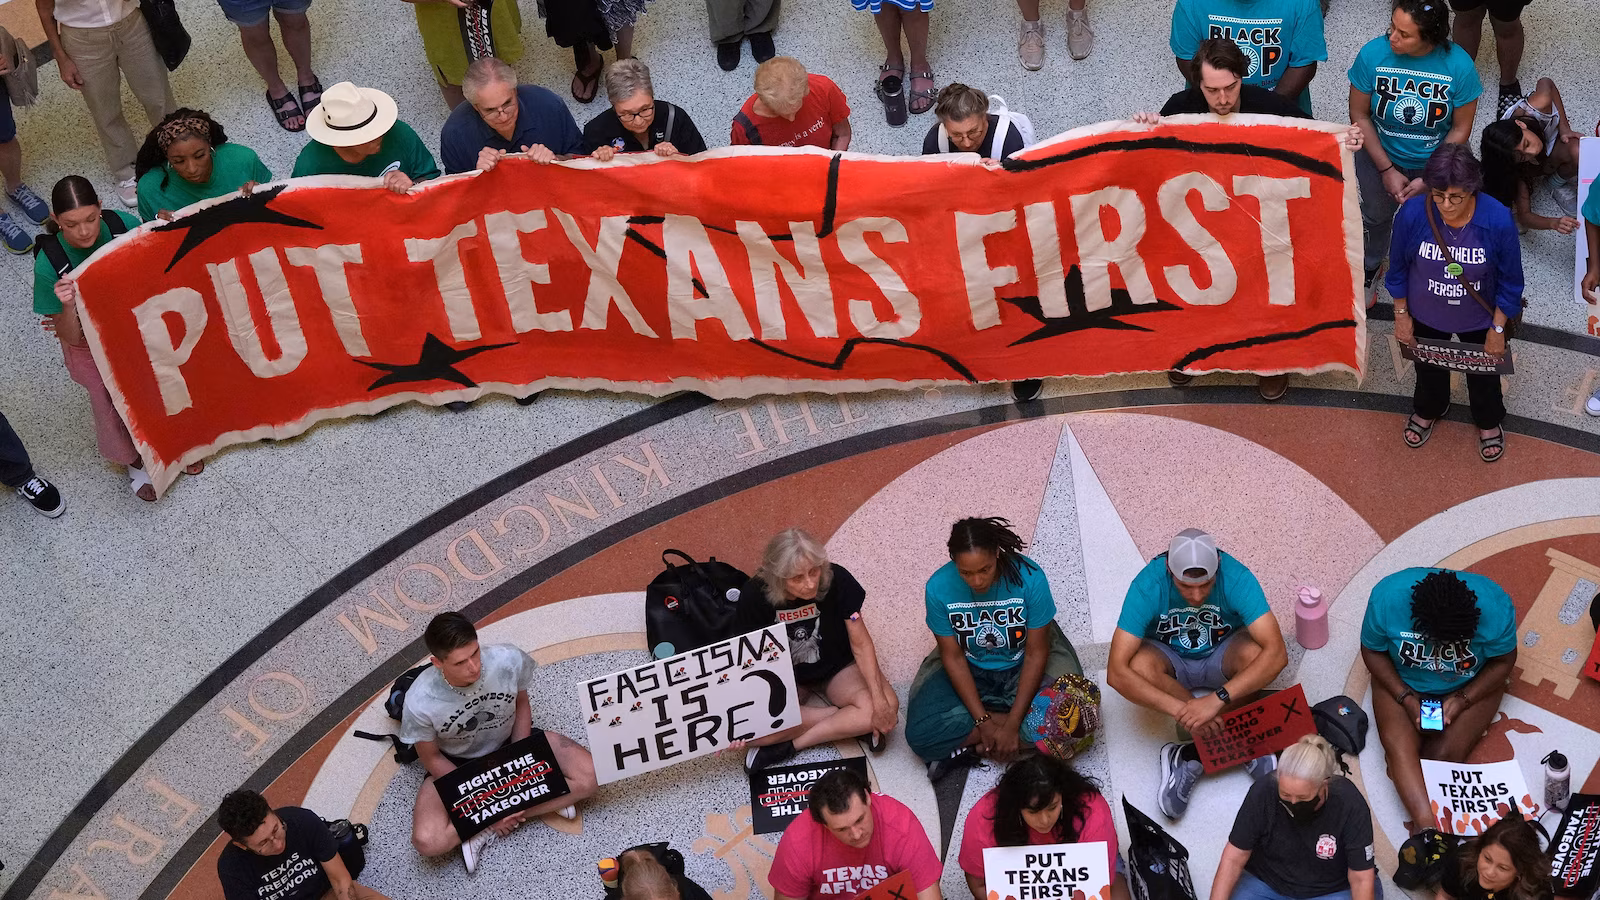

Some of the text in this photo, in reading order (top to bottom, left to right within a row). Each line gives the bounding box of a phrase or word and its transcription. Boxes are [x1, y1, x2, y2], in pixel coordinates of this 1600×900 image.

[467, 29, 480, 60] IGHT
[1208, 24, 1282, 46] BLACK
[1375, 76, 1450, 101] BLACK
[1375, 89, 1449, 128] TOP
[802, 130, 808, 138] a
[131, 170, 1311, 417] PUT TEXANS FIRST
[1416, 343, 1460, 355] FIGHT
[1418, 356, 1496, 372] TAKEOVER
[714, 394, 868, 460] THE
[333, 441, 675, 656] KINGDOM
[778, 605, 815, 621] RESIST
[949, 606, 1026, 628] BLACK
[1157, 610, 1224, 633] BLACK
[953, 624, 1027, 650] TOP
[1399, 640, 1475, 662] BLACK
[587, 629, 785, 712] FASCISM
[219, 671, 308, 758] OF
[652, 682, 709, 728] IS
[1210, 748, 1255, 766] TEXAS
[458, 753, 535, 795] FIGHT THE
[1452, 770, 1483, 784] PUT
[452, 761, 551, 817] TRUMP
[1439, 783, 1509, 799] TEXANS
[471, 784, 550, 824] TAKEOVER
[771, 804, 802, 817] THE
[1452, 798, 1499, 813] FIRST
[261, 852, 300, 882] TEXAS
[1025, 852, 1066, 868] PUT
[1581, 850, 1598, 877] THE
[258, 858, 314, 896] FREEDOM
[823, 864, 888, 882] TEXAS
[1005, 867, 1090, 884] TEXANS
[1020, 884, 1076, 900] FIRST
